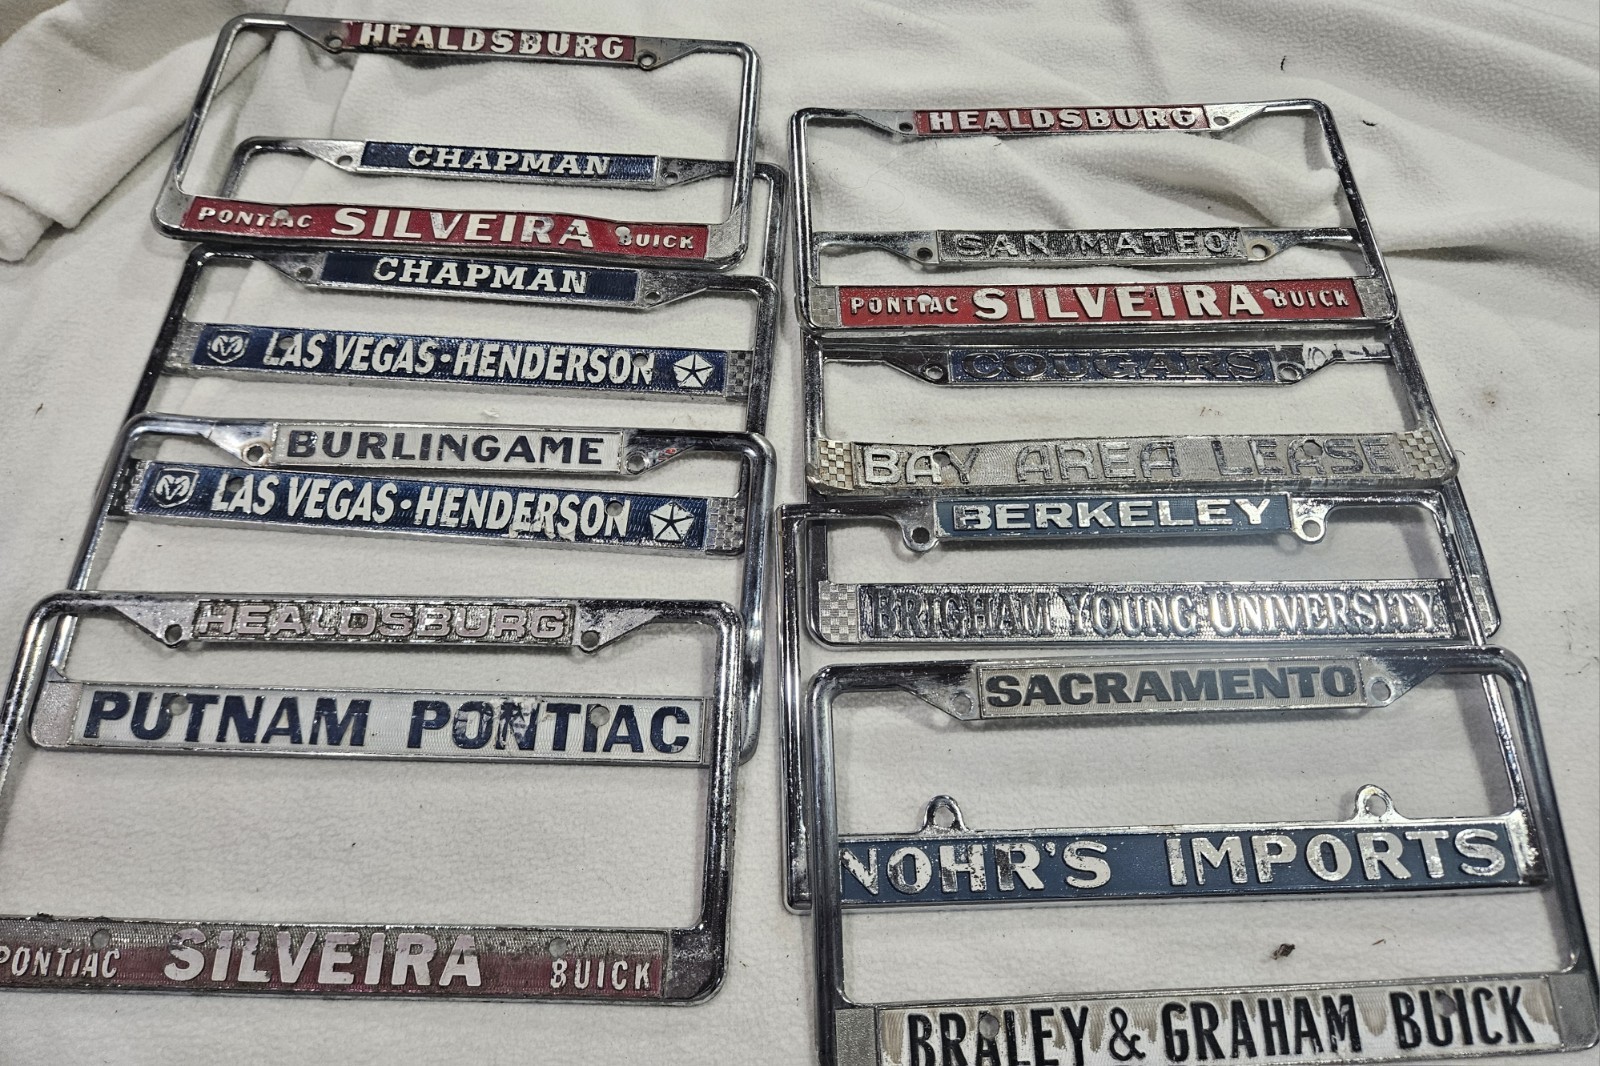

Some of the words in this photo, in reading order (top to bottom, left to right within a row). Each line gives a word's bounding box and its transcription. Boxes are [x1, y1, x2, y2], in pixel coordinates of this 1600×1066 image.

[360, 22, 624, 59] HEALDSBURG
[928, 107, 1197, 132] HEALDSBURG
[407, 146, 611, 176] CHAPMAN
[197, 206, 314, 229] PONTIAC
[330, 207, 594, 248] SILVEIRA
[617, 228, 695, 250] BUICK
[955, 232, 1050, 256] SAN
[1072, 231, 1231, 256] MATEO
[373, 256, 588, 295] CHAPMAN
[850, 295, 960, 315] PONTIAC
[971, 284, 1265, 321] SILVEIRA
[1272, 289, 1350, 308] BUICK
[263, 331, 327, 369] LAS
[960, 350, 1265, 379] COUGARS
[286, 429, 604, 465] BURLINGAME
[863, 445, 980, 485] BAY
[1016, 440, 1182, 483] AREA
[1210, 437, 1401, 476] LEASE
[210, 472, 280, 516] LAS
[953, 498, 1271, 531] BERKELEY
[199, 604, 566, 639] HEALDSBURG
[869, 587, 1055, 638] BRIGHAM
[1057, 586, 1198, 638] YOUNG
[1202, 587, 1440, 637] UNIVERSITY
[985, 665, 1357, 708] SACRAMENTO
[83, 690, 372, 747] PUTNAM
[407, 699, 691, 754] PONTIAC
[839, 839, 1112, 895] NOHR'S
[1164, 828, 1506, 886] IMPORTS
[164, 928, 482, 987] SILVEIRA
[550, 958, 651, 990] BUICK
[907, 1005, 1090, 1066] BRALEY
[1108, 1006, 1147, 1061] &
[1161, 993, 1363, 1063] GRAHAM
[1389, 985, 1536, 1049] BUICK
